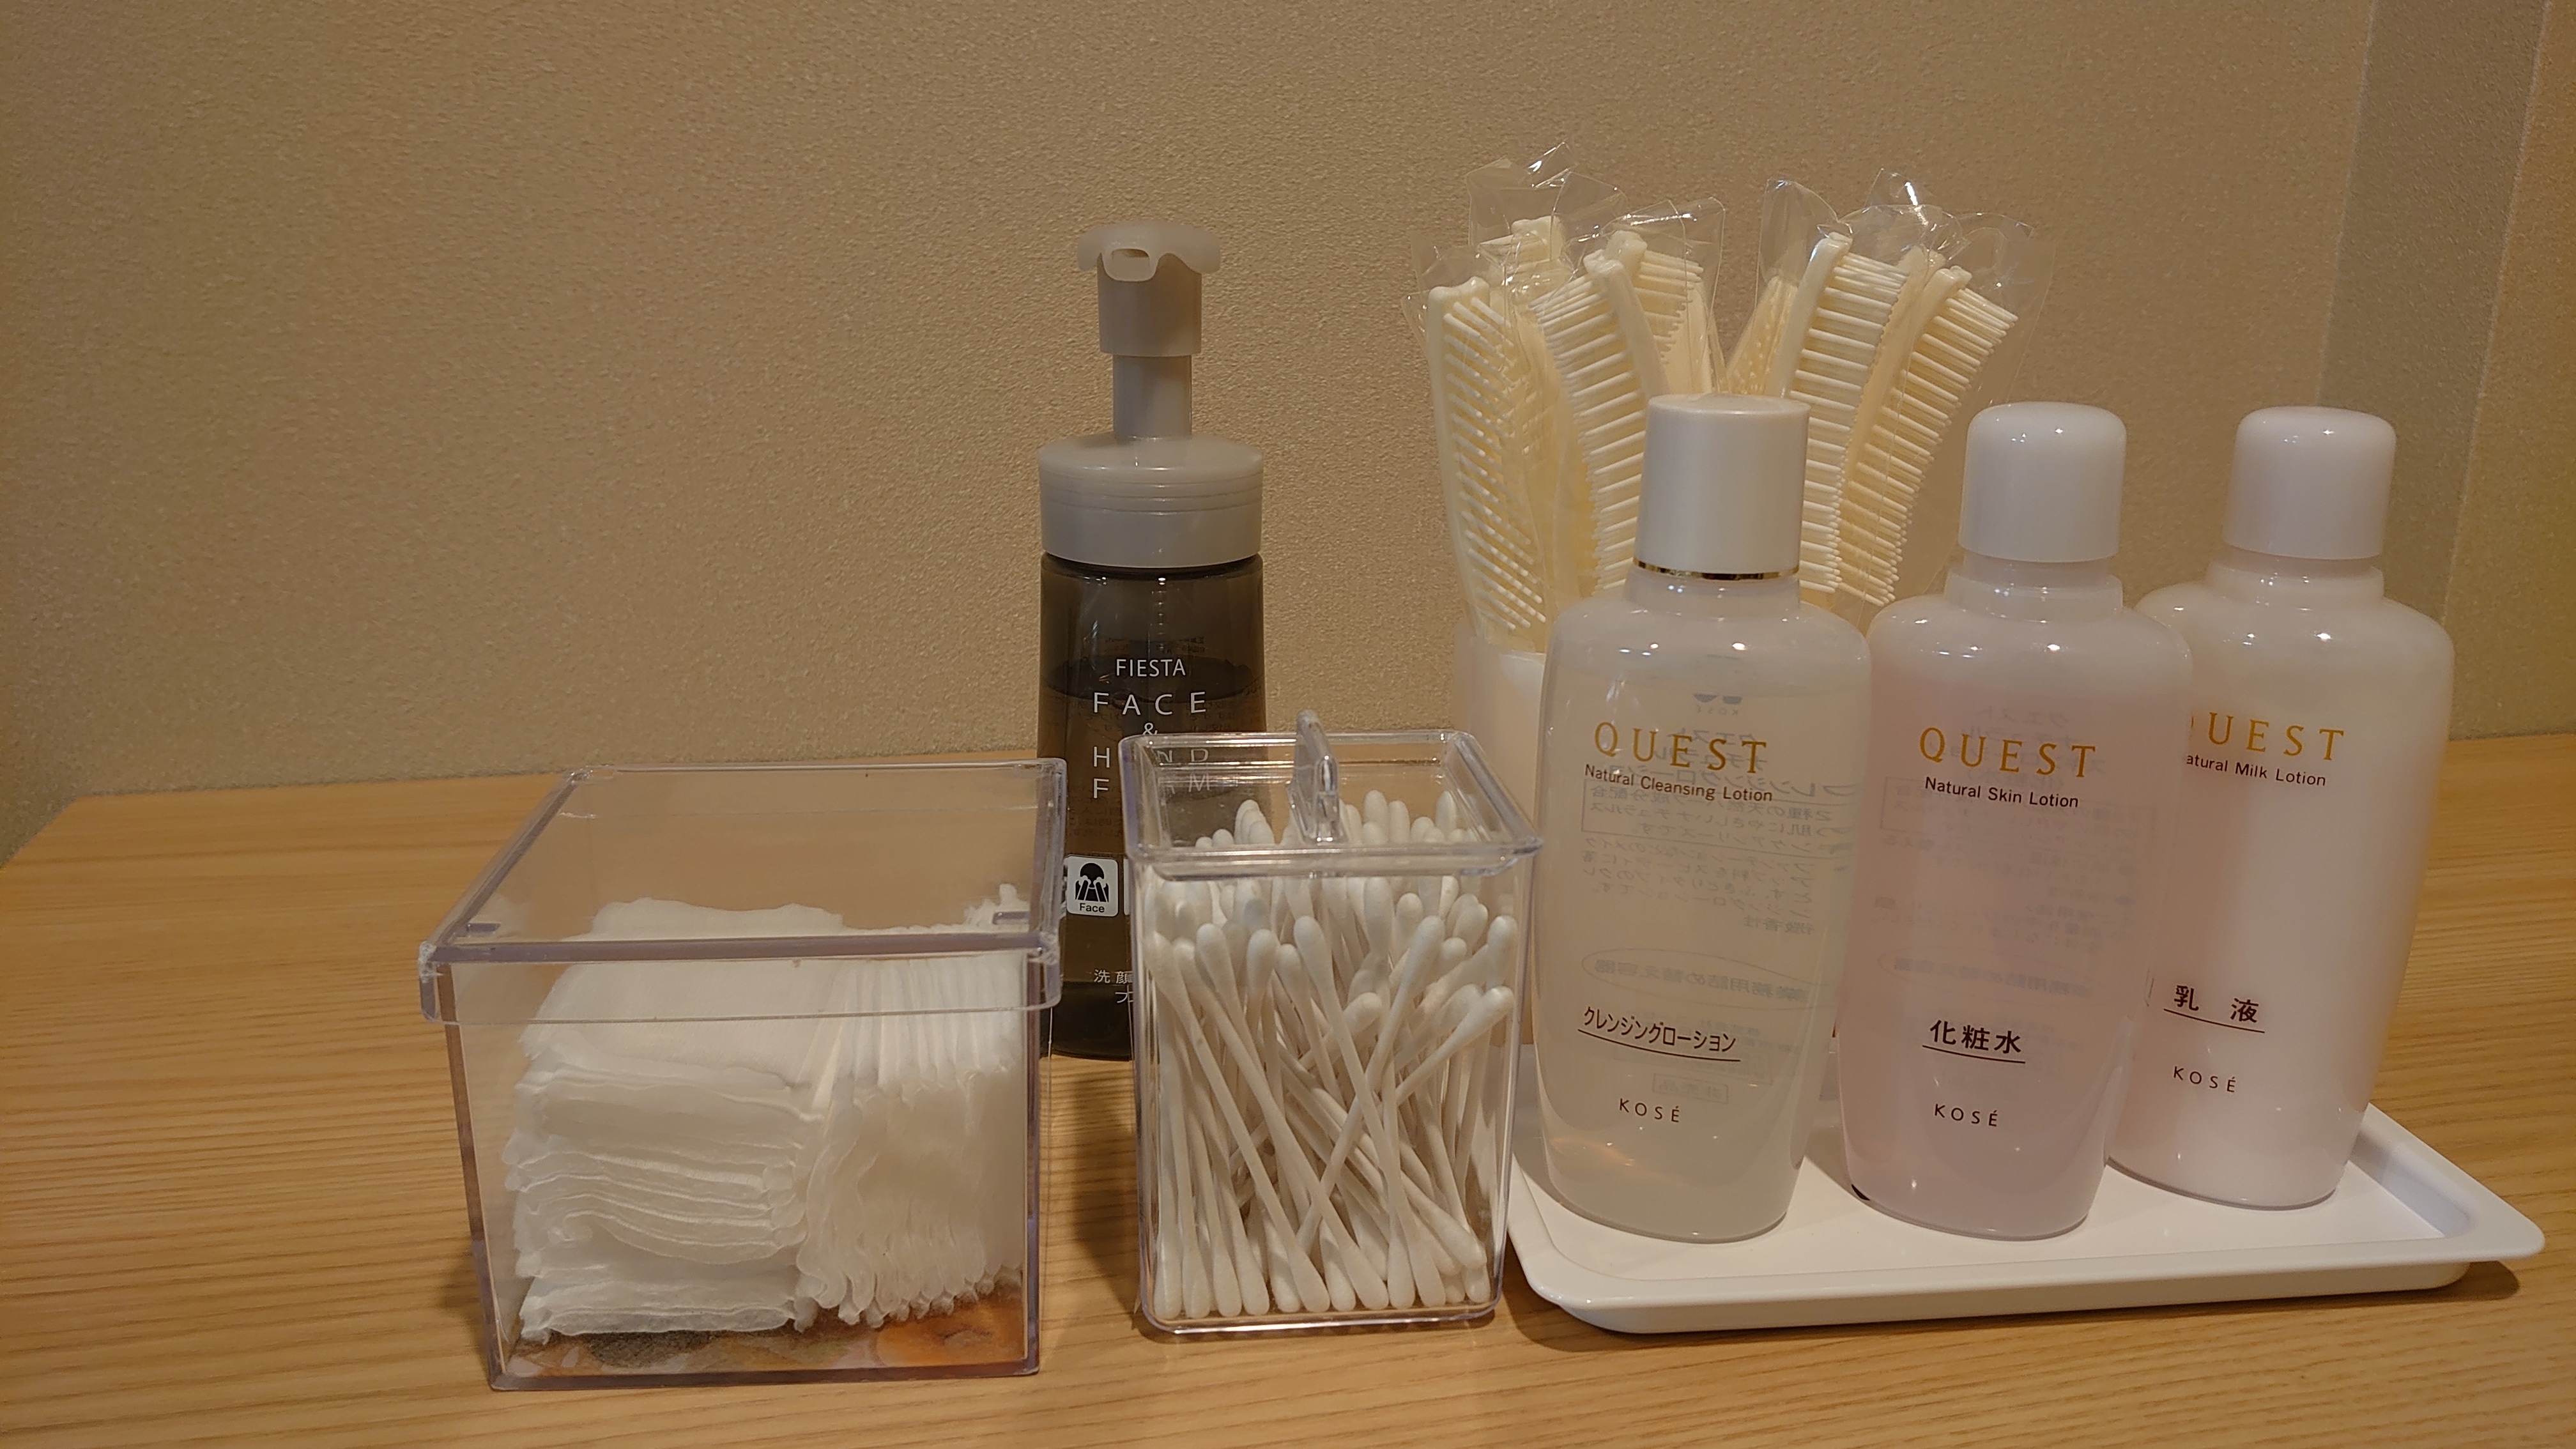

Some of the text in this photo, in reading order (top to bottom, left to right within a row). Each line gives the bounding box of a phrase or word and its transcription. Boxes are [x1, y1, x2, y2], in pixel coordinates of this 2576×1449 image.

[1116, 658, 1186, 678] FIESTA
[1093, 691, 1207, 716] FACE
[1142, 722, 1158, 736] &
[2191, 712, 2344, 761] UEST
[1093, 745, 1209, 769] HND
[1594, 721, 1767, 774] QUEST
[1919, 726, 2096, 778] QUEST
[1584, 763, 1773, 802] Natural Cleansing Lotion
[2186, 753, 2326, 786] atural Milk Lotion
[1924, 776, 1981, 799] Natural
[1988, 786, 2022, 804] Skin
[2029, 792, 2079, 808] Lotion
[1079, 903, 1105, 913] Face
[1583, 1006, 1736, 1052] クレンジングローション
[1929, 1020, 2022, 1054] 化粧水
[2173, 1066, 2237, 1093] KOSÉ
[1619, 1097, 1681, 1123] KOSÉ
[1933, 1103, 1998, 1127] KOSÉ
